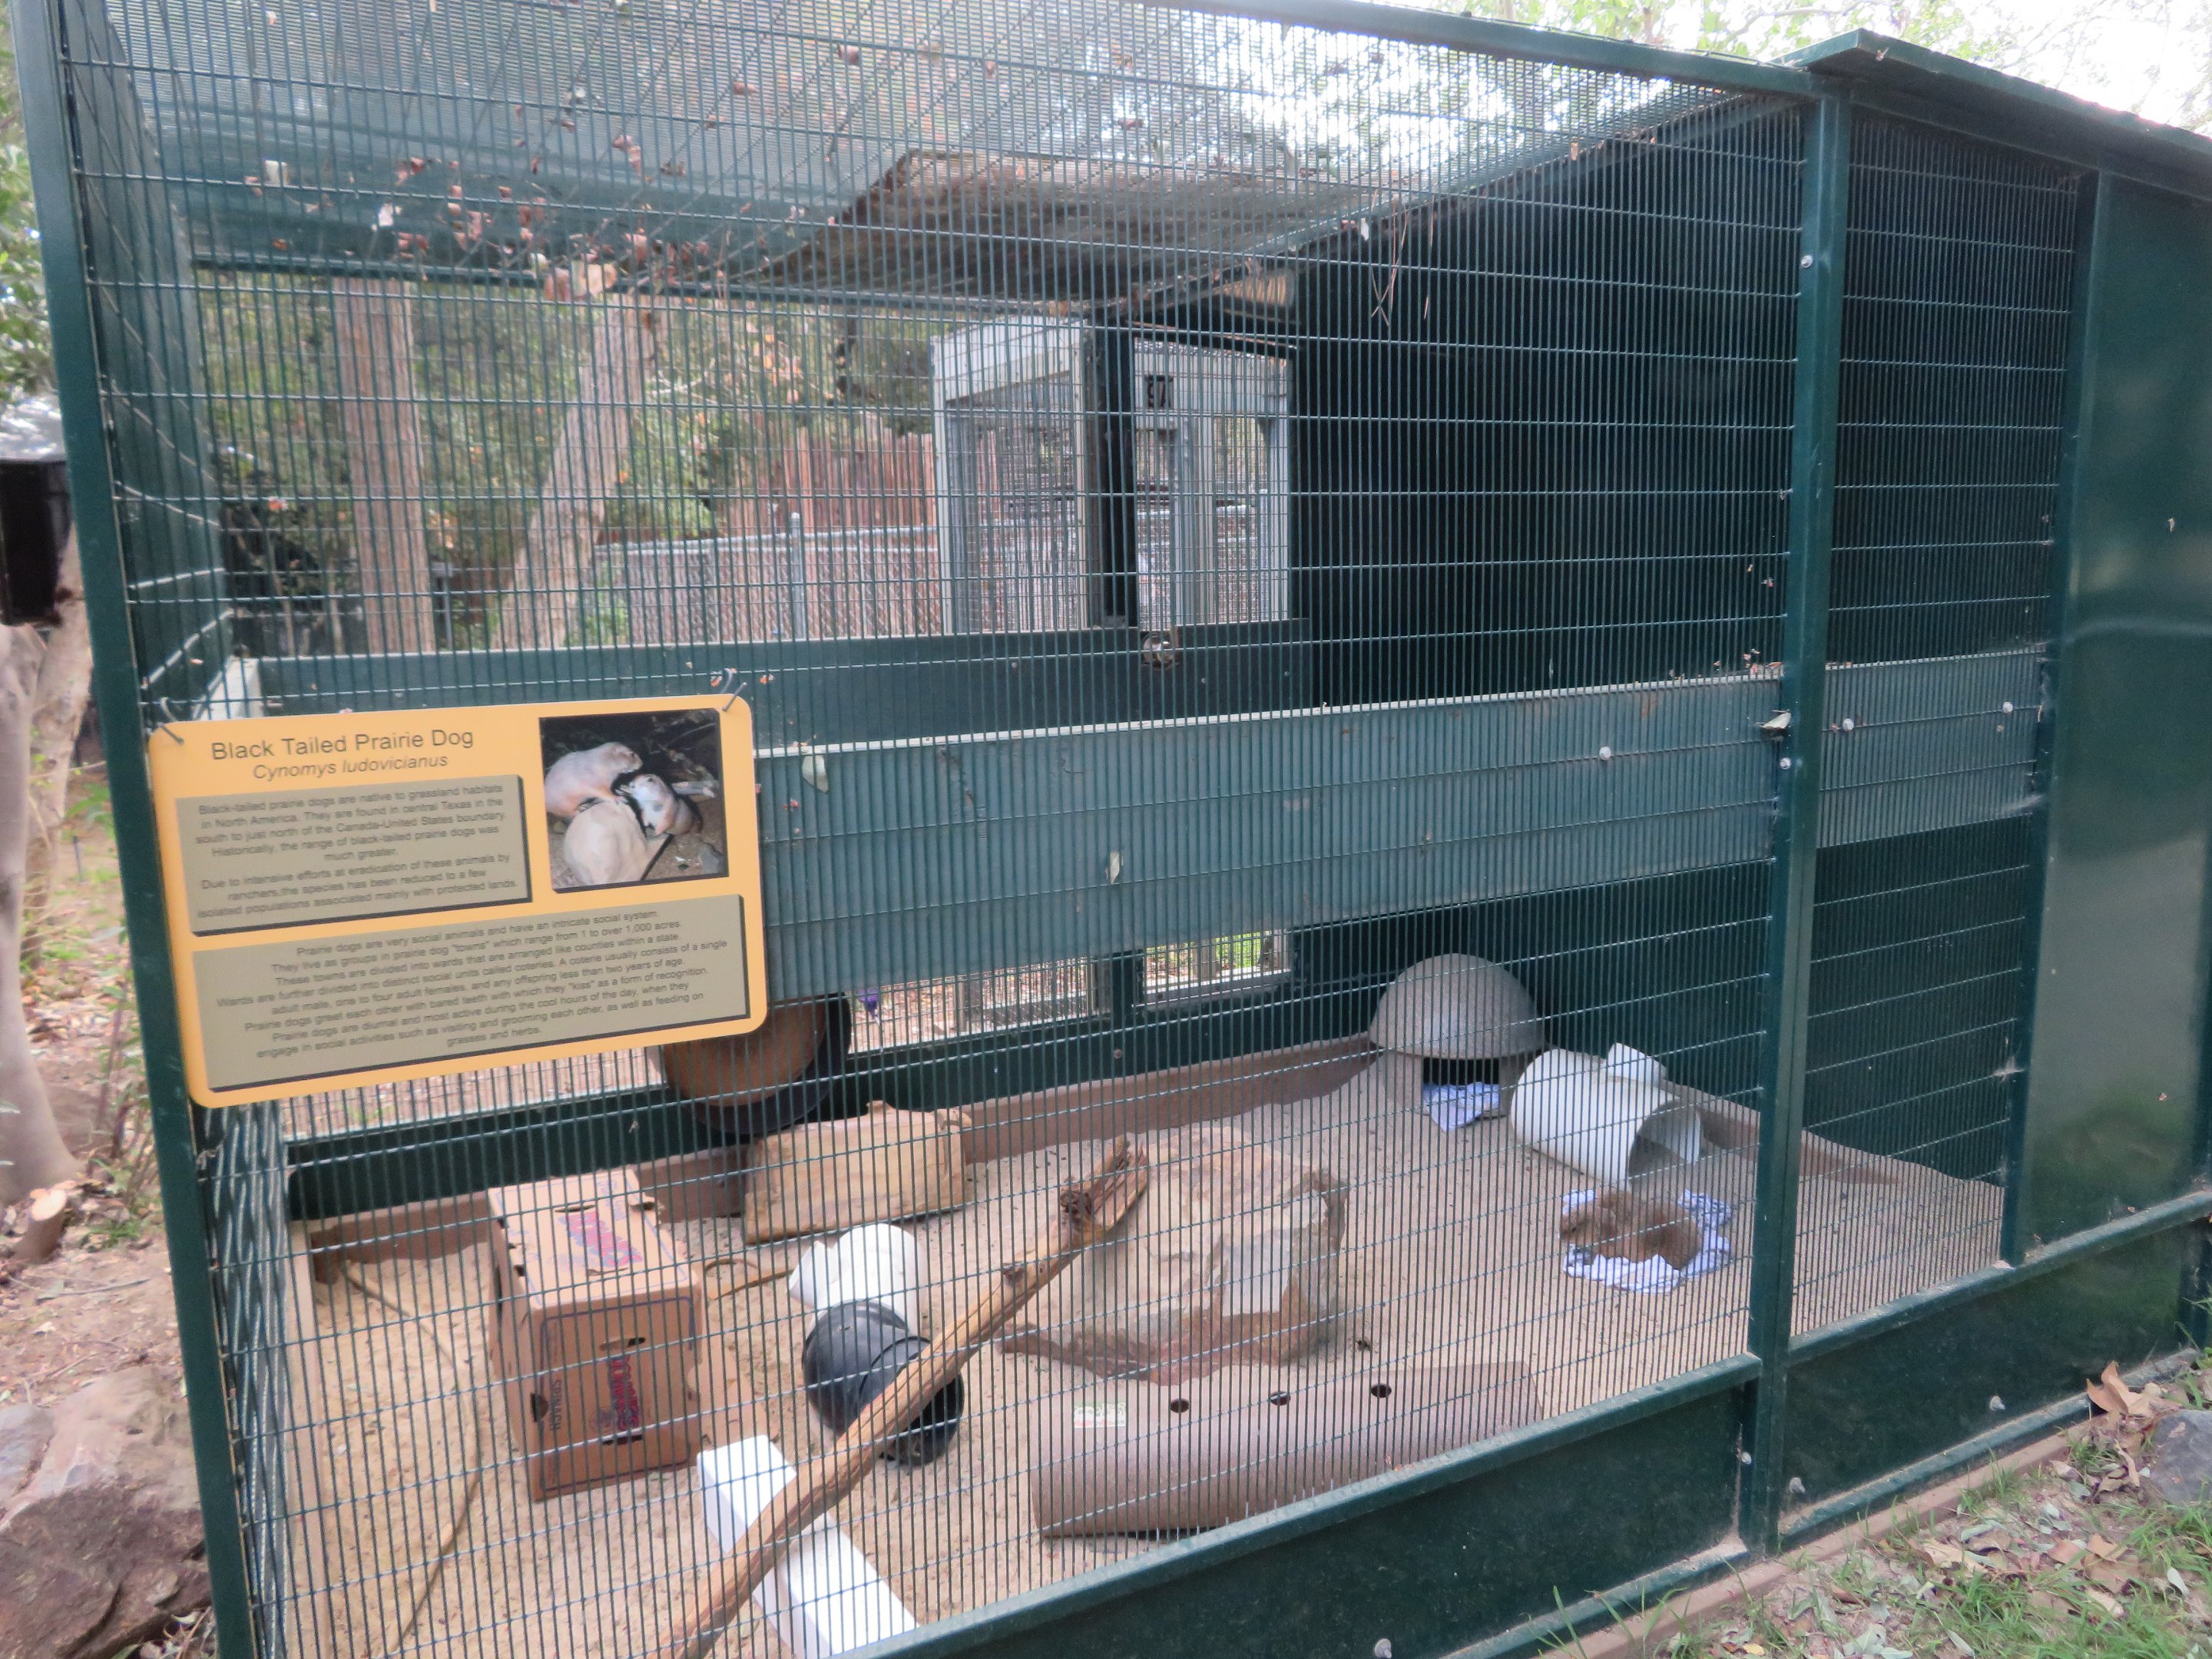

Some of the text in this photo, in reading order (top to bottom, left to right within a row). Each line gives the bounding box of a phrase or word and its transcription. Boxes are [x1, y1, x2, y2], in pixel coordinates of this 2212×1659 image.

[211, 729, 474, 760] Black Tailed Prairie Dog
[252, 754, 449, 782] Cynomys ludovicianus
[593, 912, 621, 923] social
[524, 935, 553, 944] range
[580, 929, 587, 938] 1
[601, 927, 623, 935] over
[625, 922, 651, 933] 1,000
[654, 921, 681, 929] acres.
[488, 953, 505, 962] are
[555, 945, 571, 954] like
[574, 940, 614, 952] counties
[617, 936, 644, 946] within
[655, 933, 680, 942] state.
[558, 958, 566, 966] A
[568, 954, 601, 965] coterie
[604, 949, 637, 961] usually
[640, 945, 678, 956] consists
[680, 943, 689, 952] of
[700, 939, 727, 949] single
[492, 979, 512, 988] any
[514, 973, 557, 985] offspring
[624, 962, 651, 972] years
[653, 959, 663, 967] of
[665, 958, 684, 967] age.
[544, 985, 566, 994] they
[620, 975, 641, 984] form
[644, 972, 654, 981] of
[655, 967, 708, 979] recognition.
[518, 1001, 535, 1010] the
[537, 997, 558, 1007] cool
[559, 995, 588, 1005] hours
[590, 992, 599, 1001] of
[601, 990, 617, 999] the
[619, 988, 639, 997] day,
[641, 985, 667, 994] when
[669, 982, 688, 990] they
[655, 994, 690, 1005] feeding
[549, 1379, 561, 1431] SPINACH
